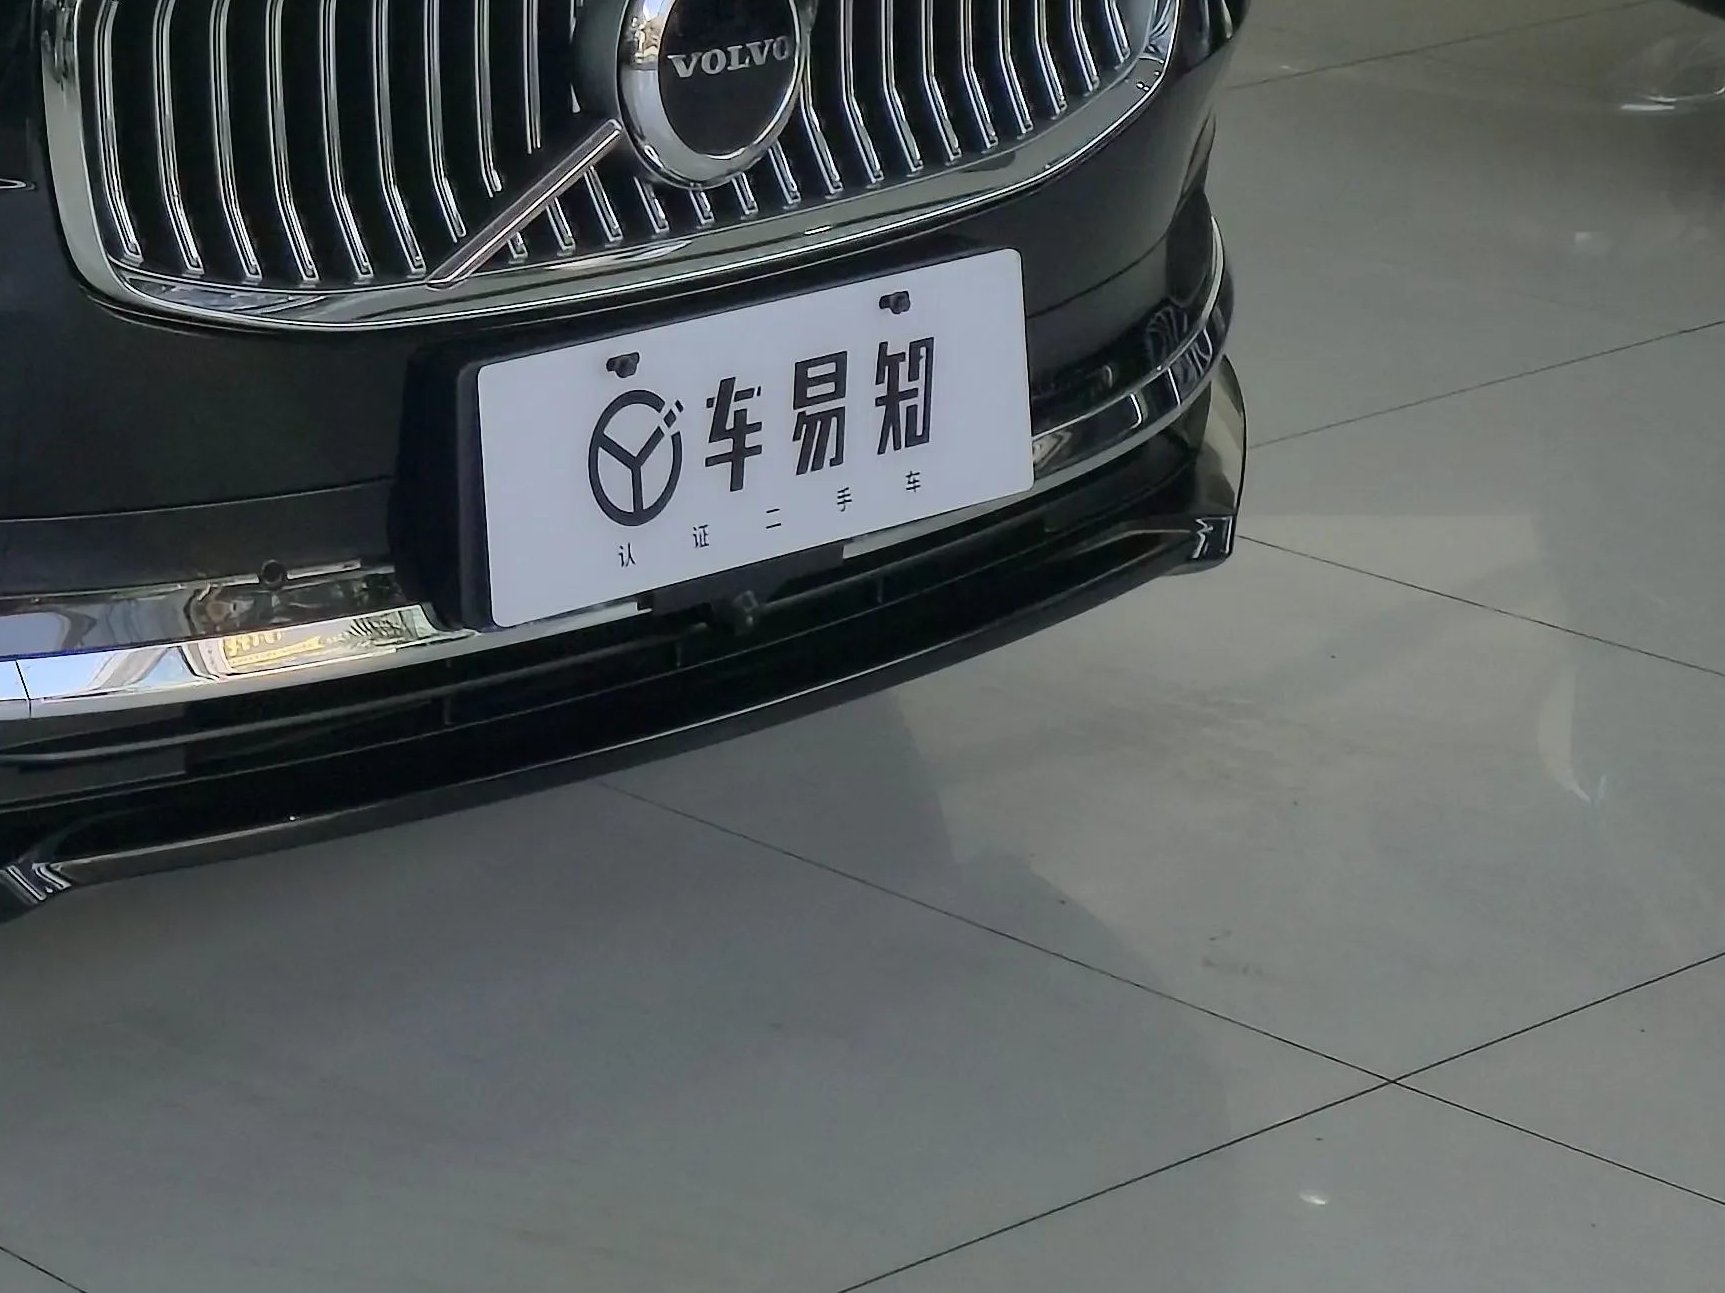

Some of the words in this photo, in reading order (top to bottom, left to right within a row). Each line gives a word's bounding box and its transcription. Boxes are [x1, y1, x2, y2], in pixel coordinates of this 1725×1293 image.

[667, 34, 792, 79] VOLVO
[704, 335, 937, 493] 车易知
[617, 469, 922, 569] 认证二手车
